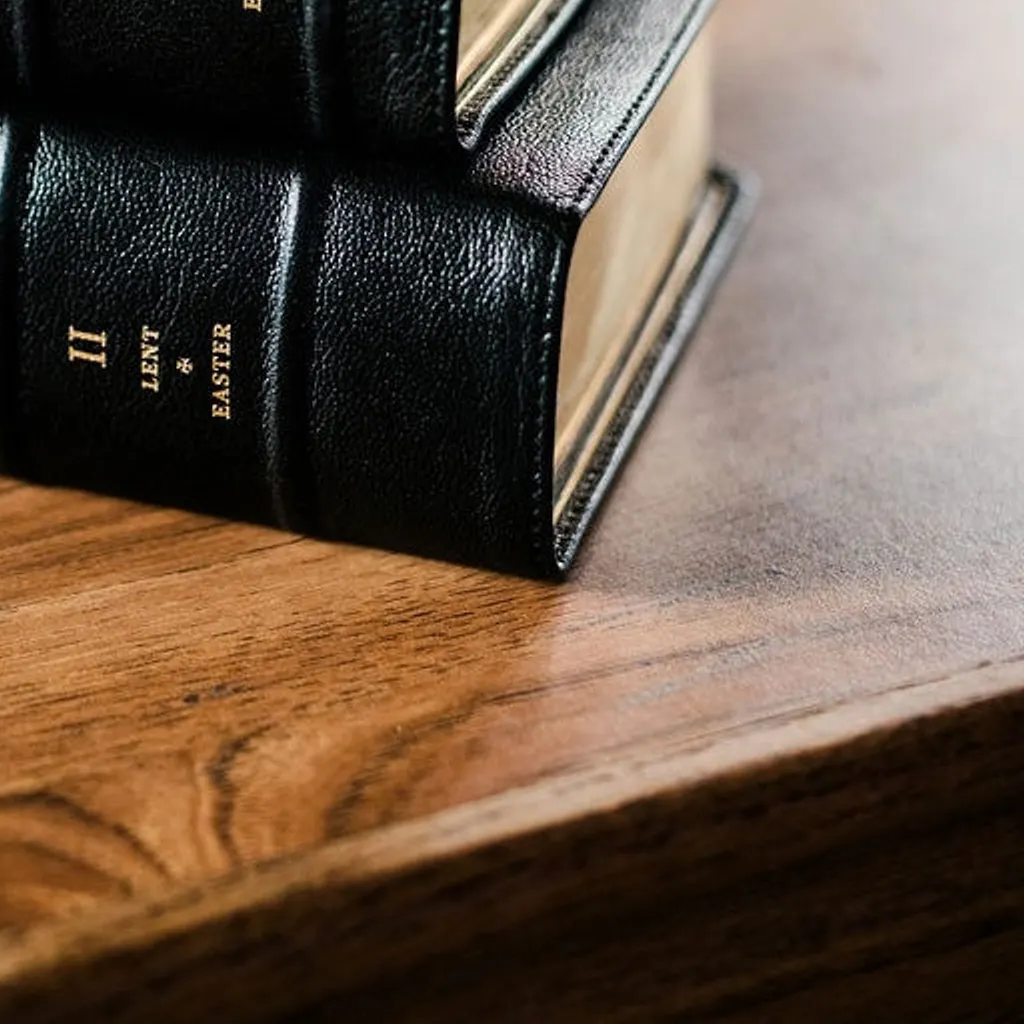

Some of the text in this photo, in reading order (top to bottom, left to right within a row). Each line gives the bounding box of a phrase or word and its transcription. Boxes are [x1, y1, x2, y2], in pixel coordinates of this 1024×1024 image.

[68, 325, 107, 368] II
[140, 324, 160, 393] LENT
[211, 323, 232, 421] EASTER
